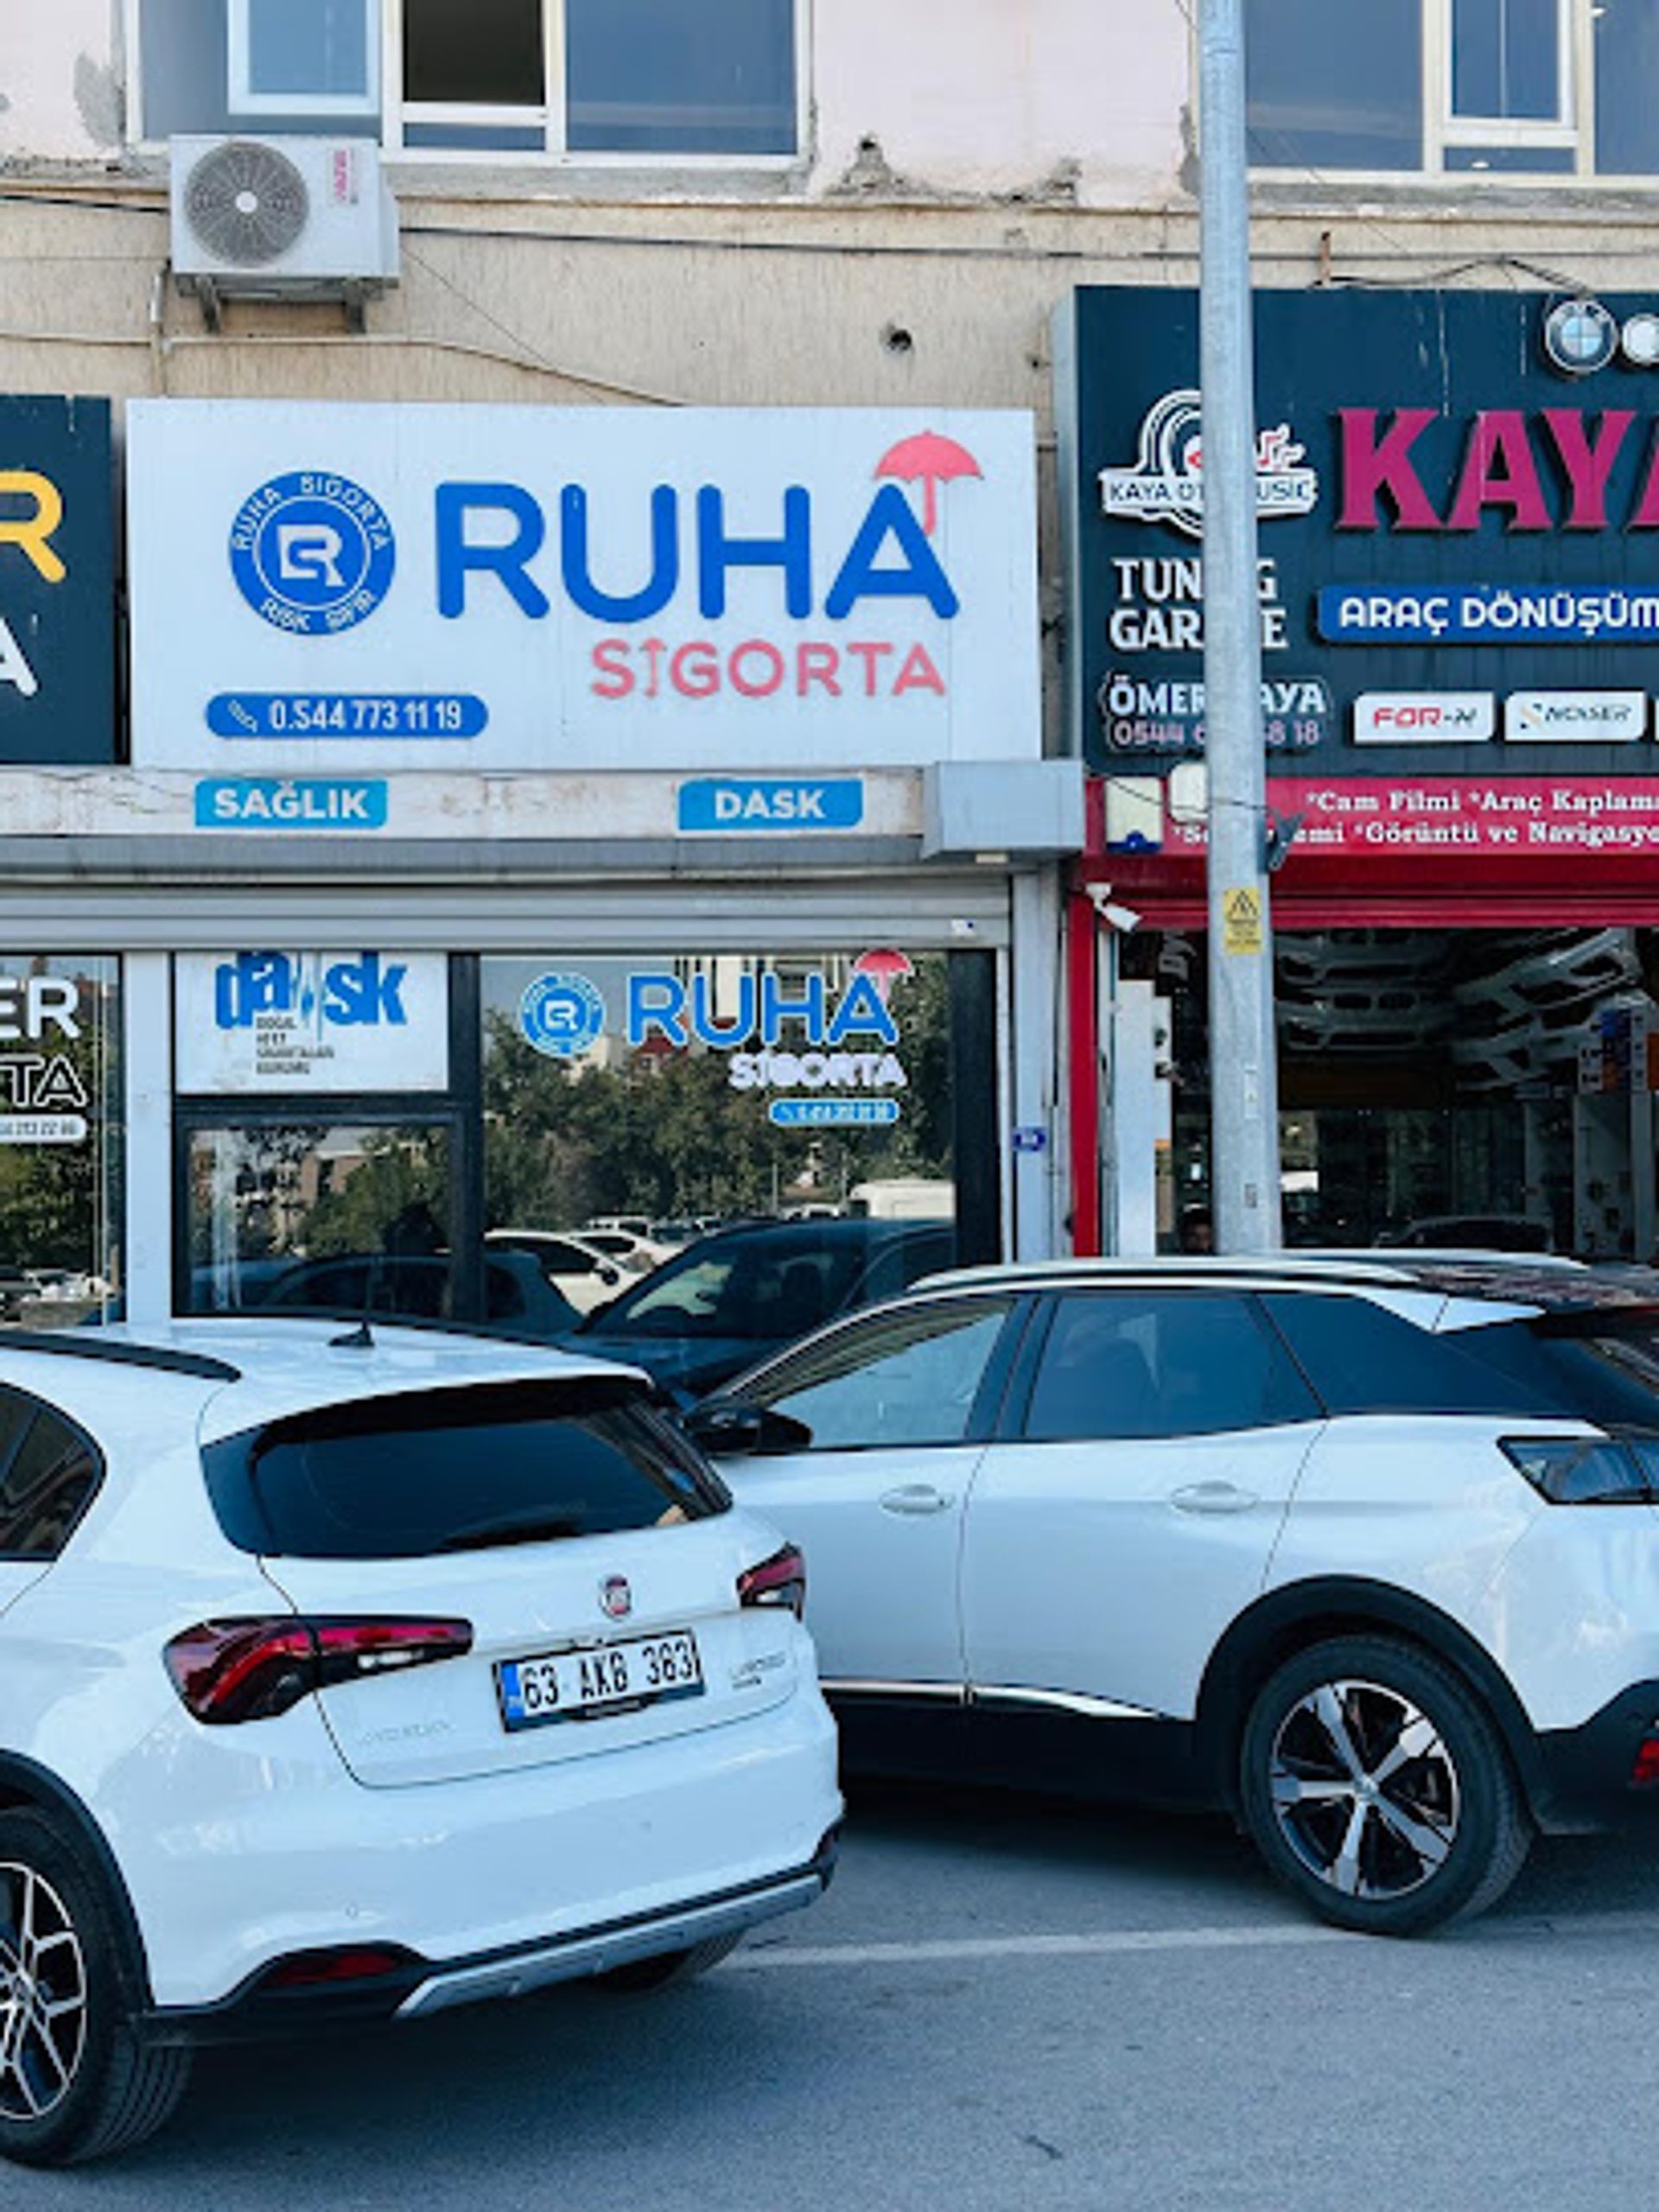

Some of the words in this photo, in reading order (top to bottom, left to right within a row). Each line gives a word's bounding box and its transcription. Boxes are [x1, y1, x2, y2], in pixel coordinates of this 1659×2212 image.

[1109, 482, 1173, 501] KAYA
[1256, 480, 1311, 501] USIC
[435, 481, 961, 623] RUHA
[1110, 557, 1278, 601] TUNG
[1109, 607, 1289, 651] GARE
[1341, 596, 1449, 636] ARAÇ
[269, 699, 346, 730] 0.544
[352, 699, 397, 730] 773
[404, 699, 429, 730] 11
[435, 699, 462, 730] 19
[1259, 683, 1326, 714] AYA
[213, 780, 370, 819] SAĞLIK
[715, 790, 826, 820] DASK
[1316, 789, 1380, 811] Cam
[1389, 788, 1462, 811] Filmi
[1479, 788, 1543, 817] Araç
[1364, 821, 1480, 844] Görüntü
[1487, 826, 1519, 843] ve
[626, 972, 899, 1046] RUHA
[521, 1664, 559, 1709] 63
